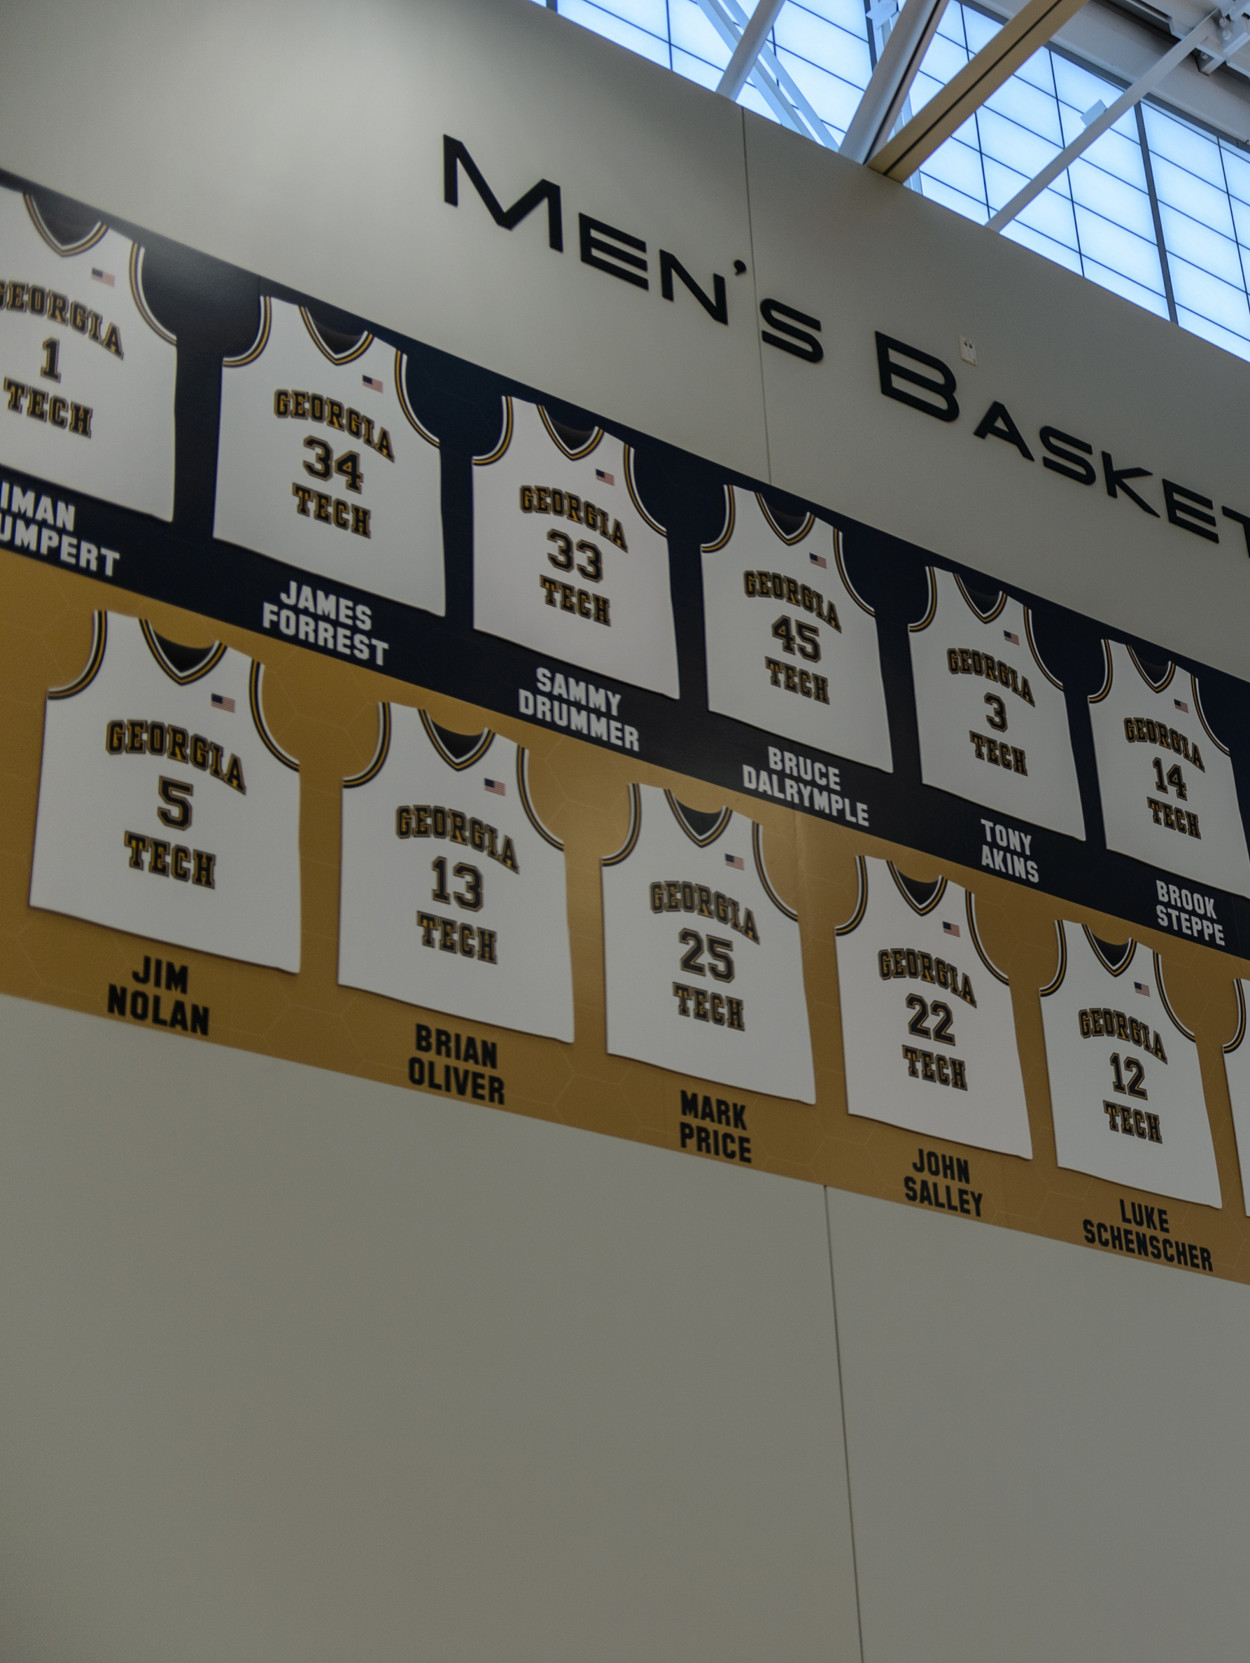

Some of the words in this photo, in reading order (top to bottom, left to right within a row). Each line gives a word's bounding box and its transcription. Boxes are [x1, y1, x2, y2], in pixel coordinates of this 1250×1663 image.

[443, 133, 824, 364] MEN'S
[40, 338, 62, 382] 1
[3, 377, 92, 438] TECH
[273, 389, 395, 463] GEORGIA
[303, 435, 363, 493] 34
[292, 483, 371, 539] TECH
[519, 485, 628, 553] GEORGIA
[547, 529, 603, 583] 33
[280, 580, 372, 631] JAMES
[539, 574, 611, 627] TECH
[744, 570, 842, 634] GEORGIA
[262, 601, 389, 666] FORREST
[772, 614, 821, 663] 45
[536, 667, 621, 717] SAMMY
[765, 656, 830, 705] TECH
[946, 648, 1036, 708] GEORGIA
[518, 689, 640, 751] DRUMMER
[984, 692, 1007, 733] 3
[106, 719, 246, 795] GEORGIA
[768, 746, 840, 791] BRUCE
[969, 730, 1028, 776] TECH
[1123, 717, 1205, 773] GEORGIA
[157, 775, 194, 831] 5
[742, 765, 869, 827] DALRYMPLE
[1152, 757, 1187, 801] 14
[396, 804, 519, 875] GEORGIA
[980, 819, 1032, 856] TONY
[1146, 796, 1201, 840] TECH
[124, 830, 216, 890] TECH
[431, 855, 484, 912] 13
[981, 845, 1039, 884] AKINS
[650, 880, 760, 944] GEORGIA
[1156, 880, 1217, 919] BROOK
[1156, 904, 1225, 947] STEPPE
[416, 910, 498, 965] TECH
[679, 927, 735, 983] 25
[132, 955, 188, 995] JIM
[878, 948, 977, 1009] GEORGIA
[107, 984, 210, 1036] NOLAN
[672, 981, 745, 1032] TECH
[905, 993, 956, 1046] 22
[415, 1023, 498, 1070] BRIAN
[1078, 1008, 1168, 1064] GEORGIA
[408, 1057, 505, 1105] OLIVER
[902, 1044, 968, 1091] TECH
[1109, 1051, 1148, 1100] 12
[680, 1089, 747, 1131] MARK
[1103, 1099, 1163, 1144] TECH
[680, 1121, 752, 1164] PRICE
[912, 1148, 970, 1185] JOHN
[904, 1176, 983, 1217] SALLEY
[1119, 1198, 1170, 1234] LUKE
[1082, 1219, 1213, 1272] SCHENSCHER
